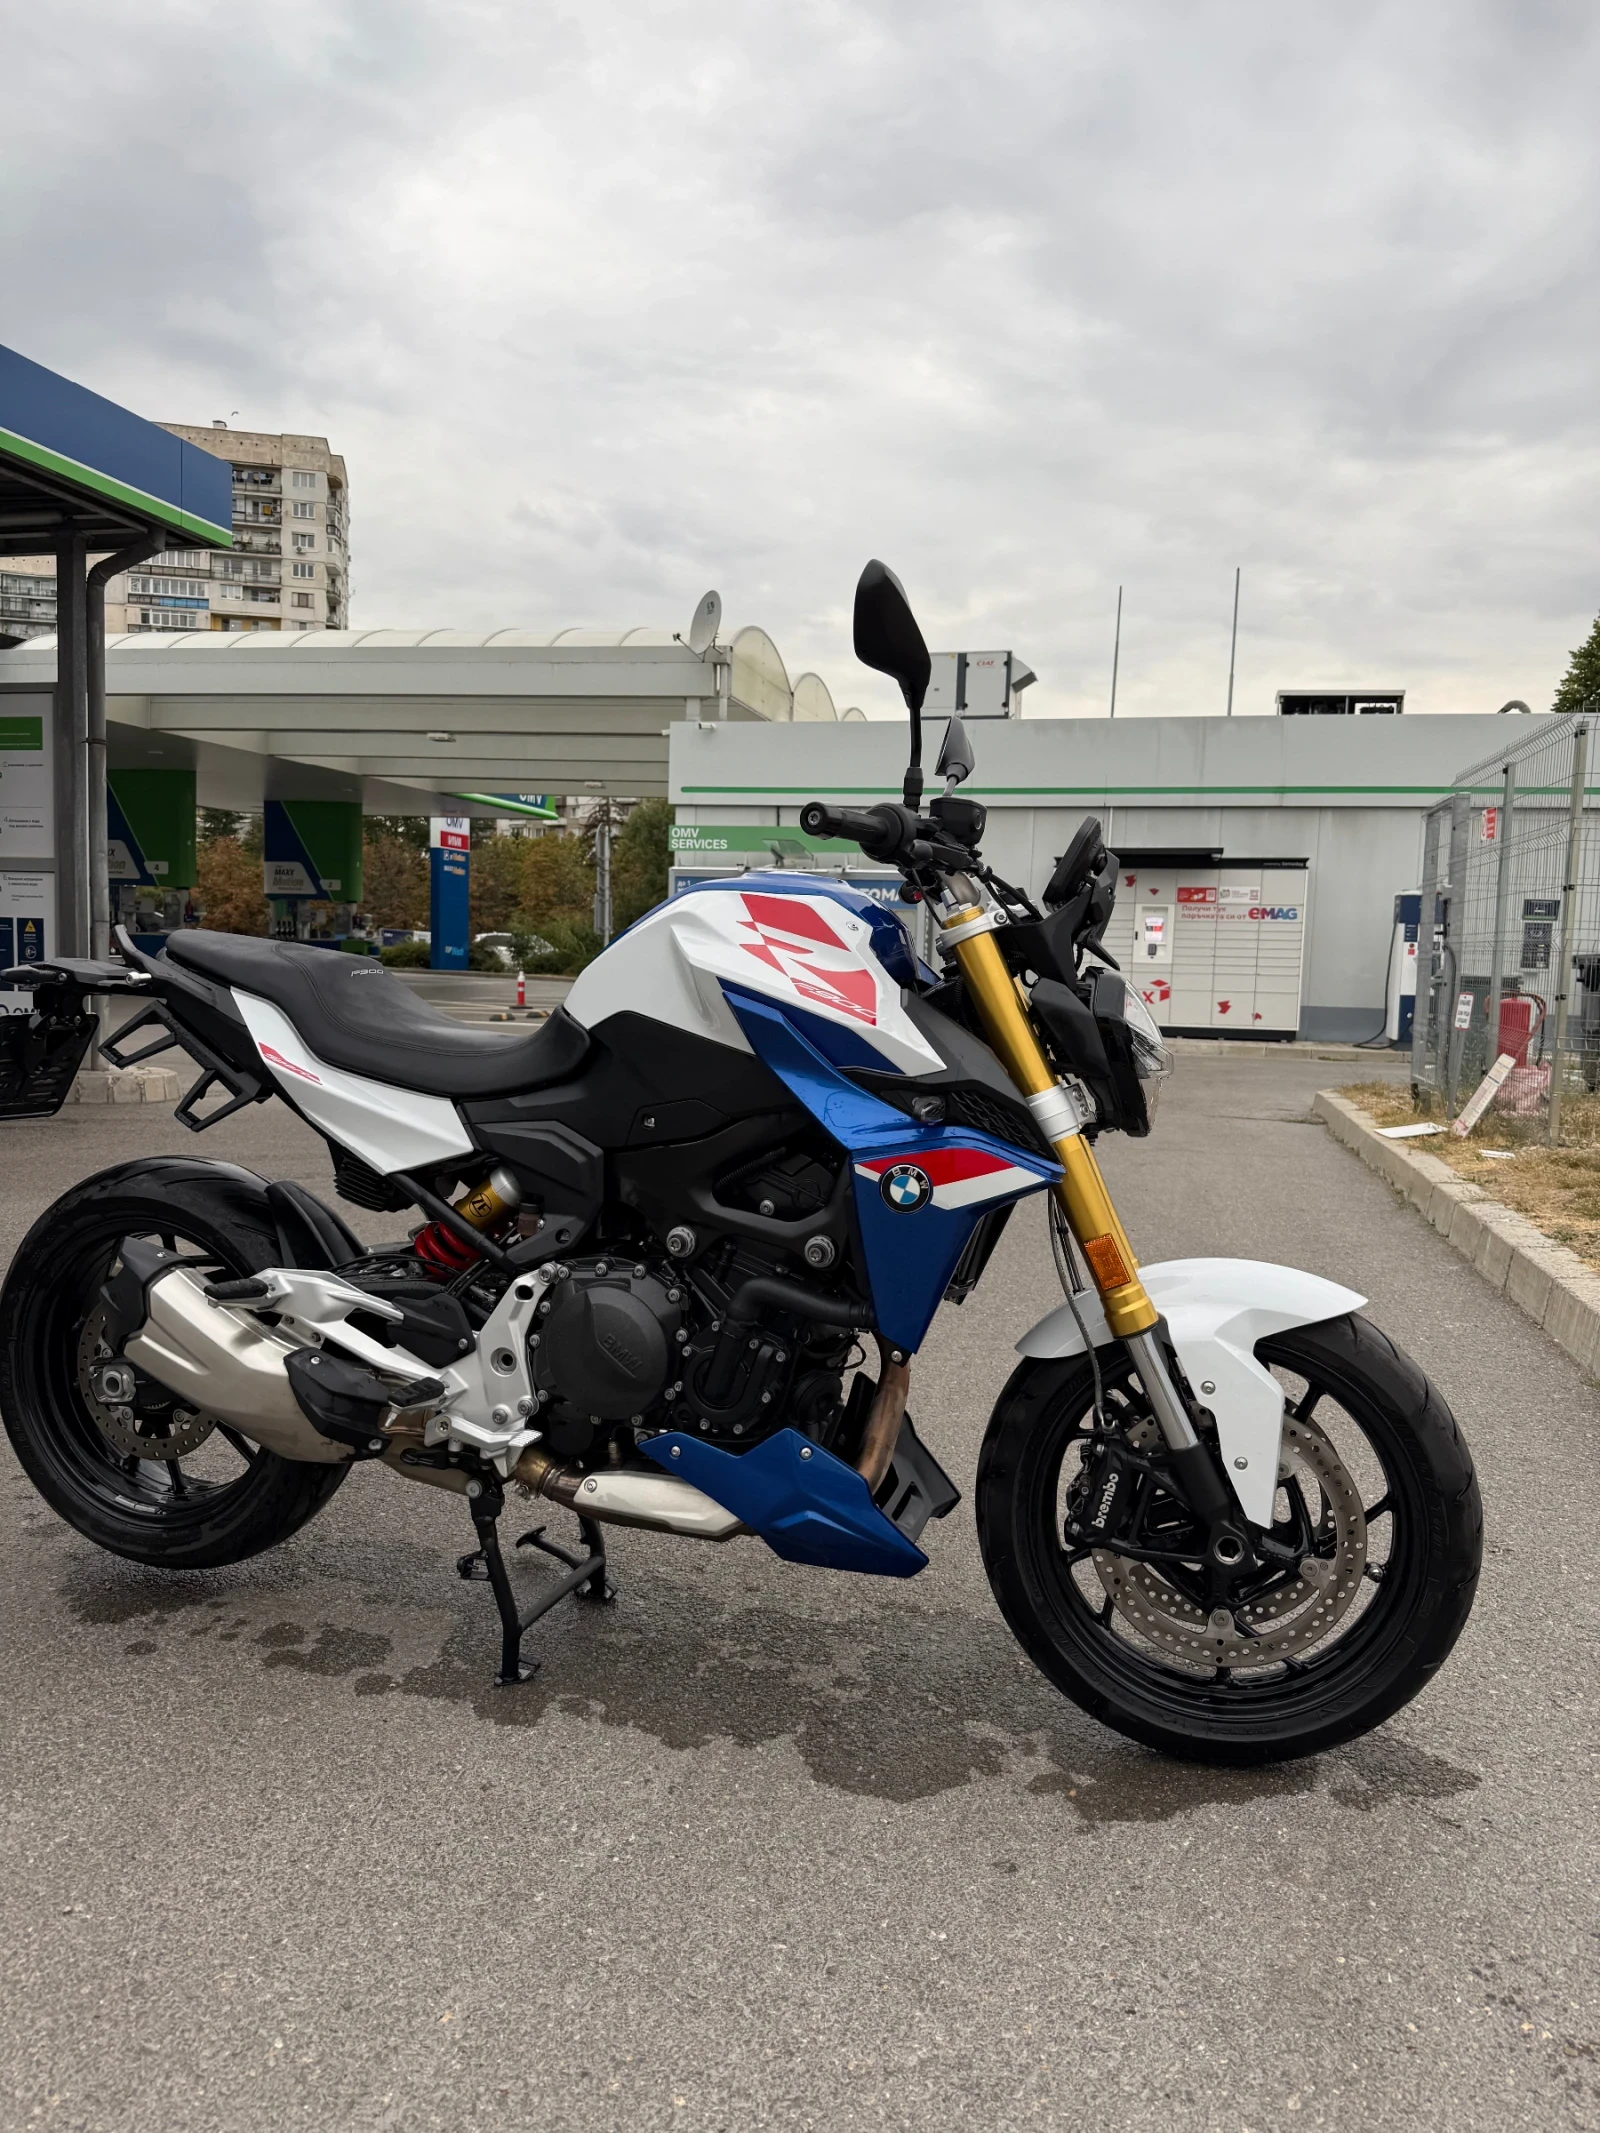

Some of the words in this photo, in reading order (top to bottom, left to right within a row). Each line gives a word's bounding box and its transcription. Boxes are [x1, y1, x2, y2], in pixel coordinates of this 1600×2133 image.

[671, 827, 700, 838] OMV
[671, 838, 728, 850] SERVICES
[154, 863, 160, 872] 4
[1181, 904, 1212, 913] Получи
[1248, 907, 1298, 920] eMAG
[470, 1192, 492, 1217] ZF
[602, 1334, 644, 1372] BMW
[1091, 1473, 1119, 1529] brembo
